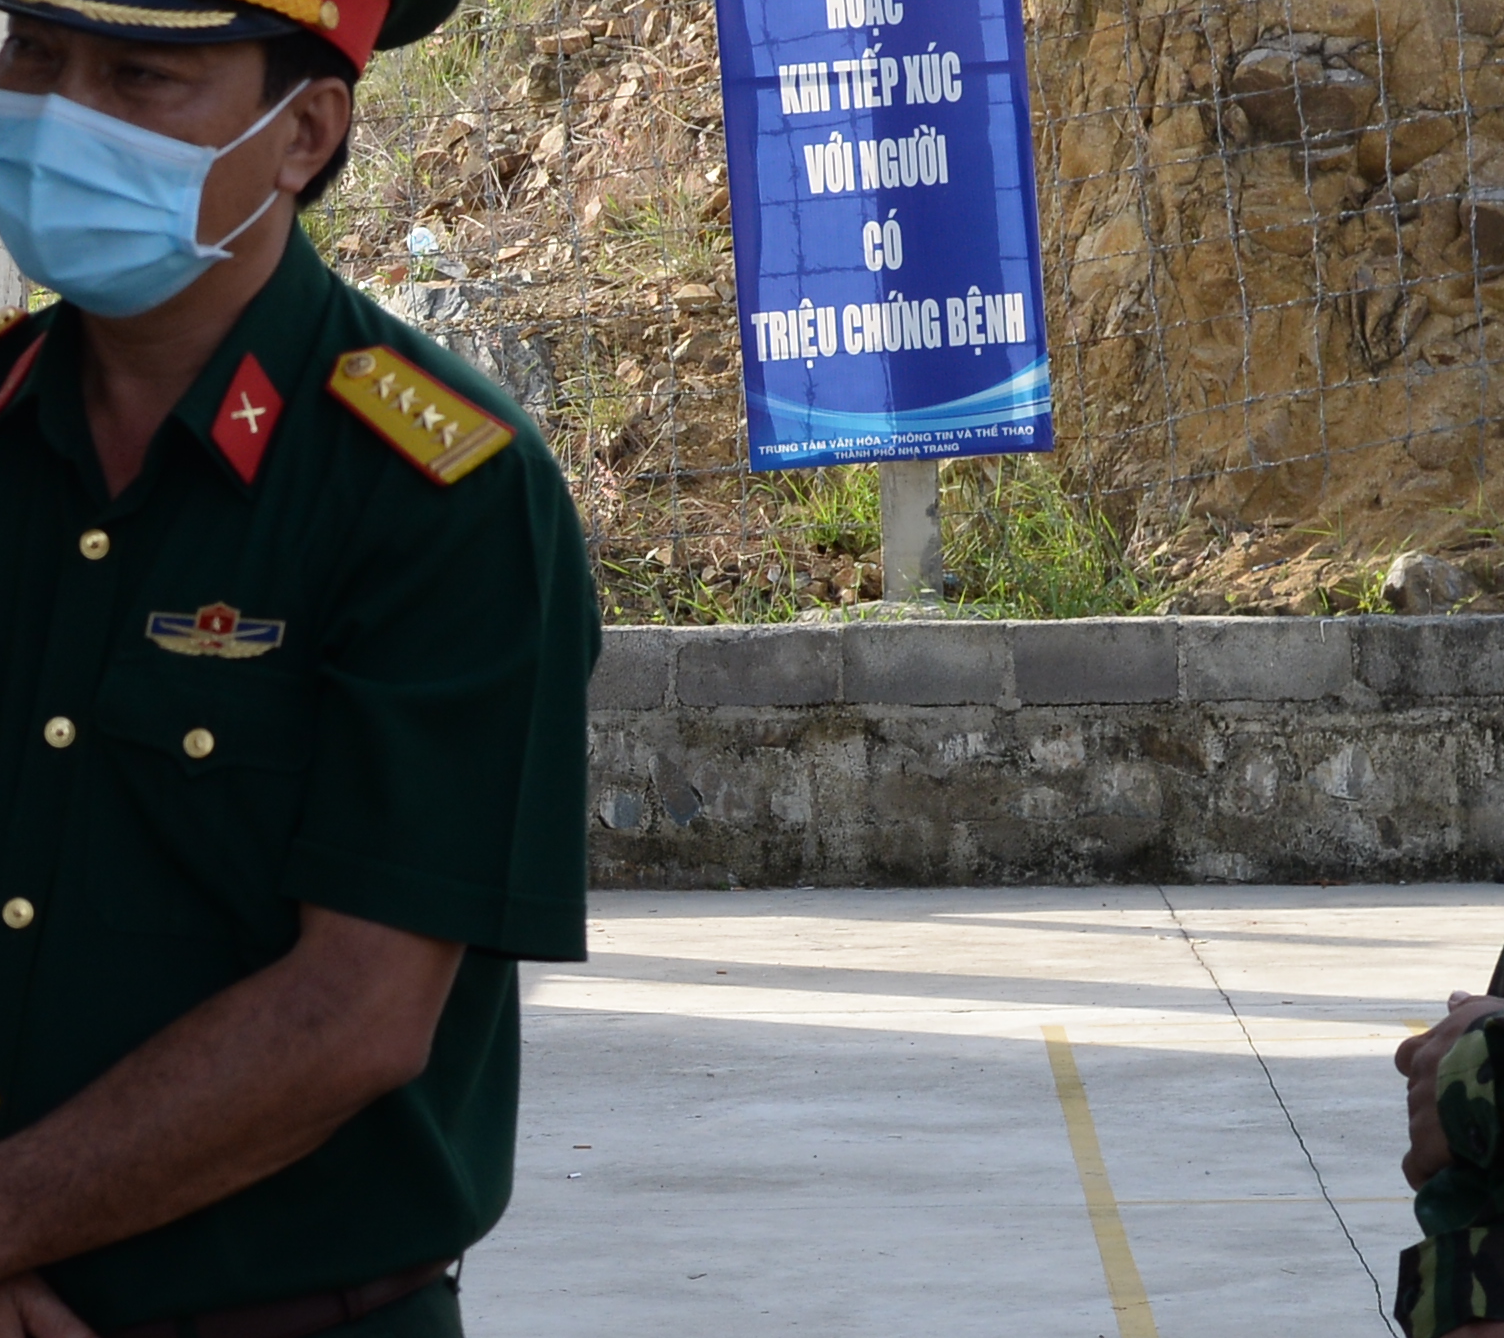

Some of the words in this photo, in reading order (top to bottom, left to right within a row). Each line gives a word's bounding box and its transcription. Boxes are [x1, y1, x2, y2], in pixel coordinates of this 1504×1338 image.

[779, 62, 830, 115] KHI
[833, 43, 899, 110] TIẾP
[903, 42, 962, 105] XÚC
[803, 131, 855, 194] VỚI
[859, 124, 948, 190] NGƯỜI
[863, 208, 903, 271] CÓ
[751, 298, 837, 369] TRIỆU
[842, 290, 941, 355] CHỨNG
[946, 285, 1026, 355] BỆNH
[758, 443, 799, 456] TRUNG
[801, 438, 826, 452] TÂM
[829, 435, 853, 449] VĂN
[856, 433, 881, 446] HÓA
[890, 430, 932, 444] THÔNG
[935, 429, 954, 441] TIN
[956, 427, 973, 439] VÀ
[1001, 425, 1035, 436] THAO
[834, 447, 870, 460] THÀNH
[898, 445, 922, 457] NHA
[923, 442, 960, 454] TRANG
